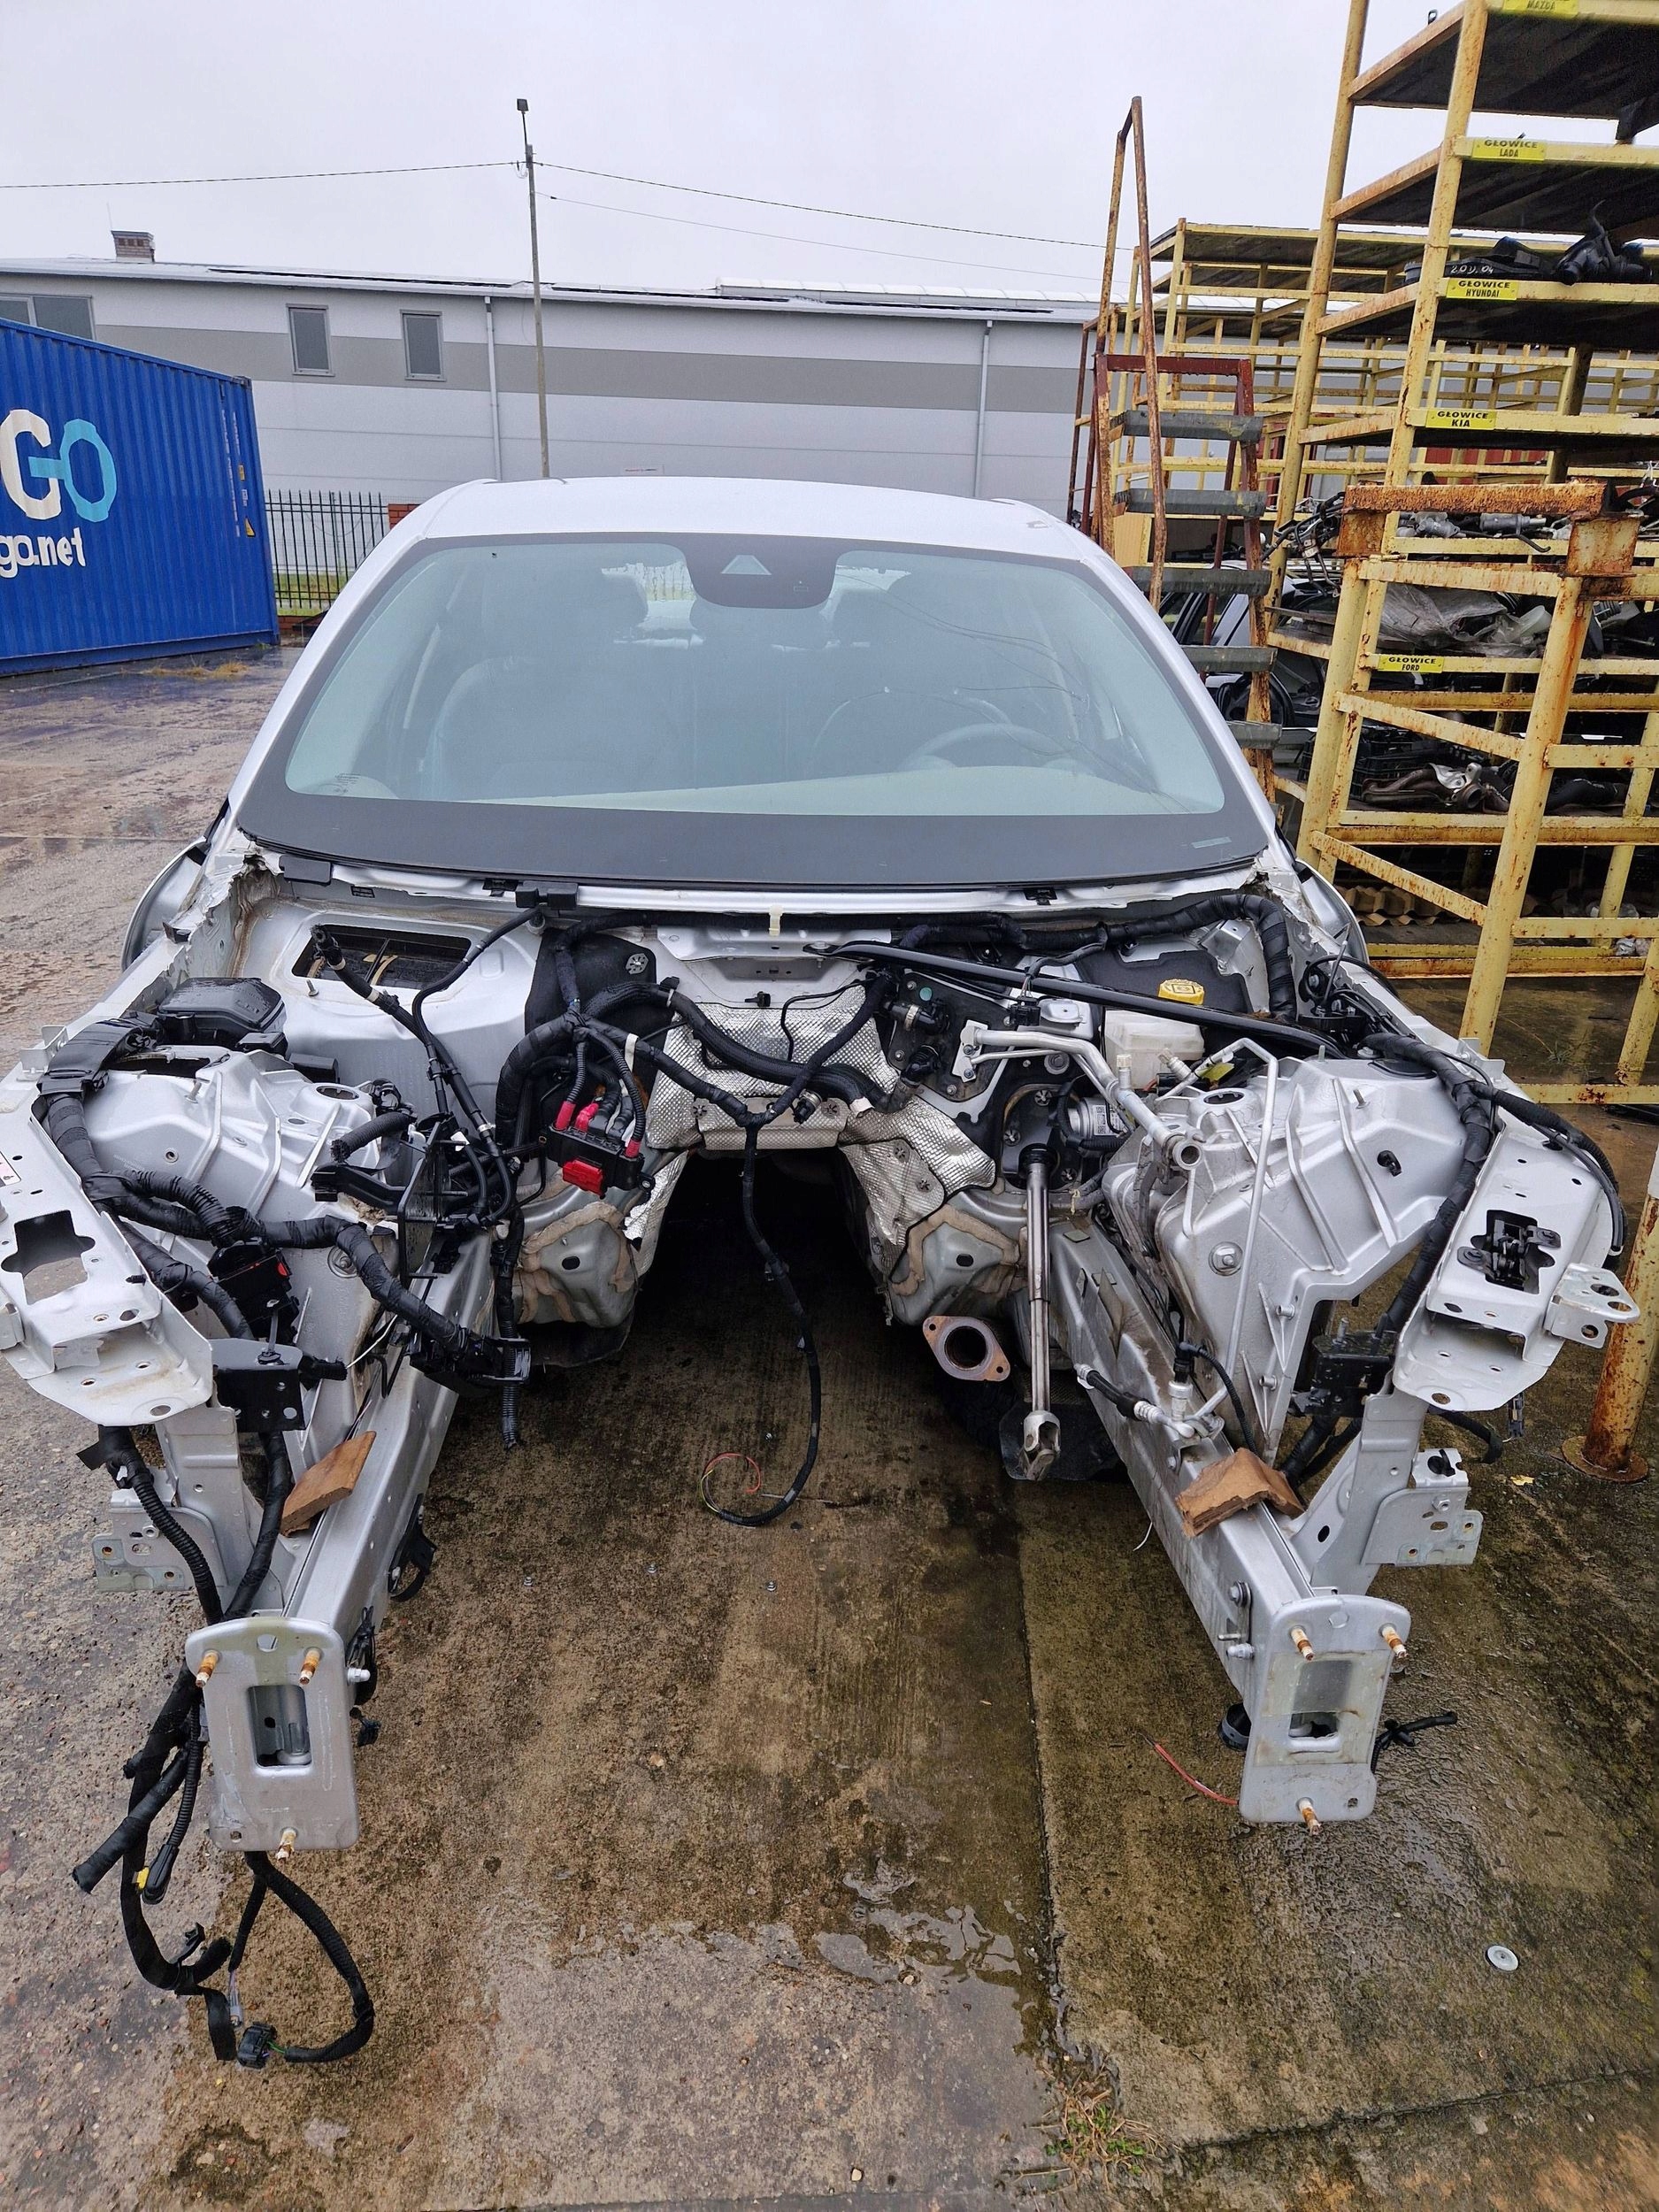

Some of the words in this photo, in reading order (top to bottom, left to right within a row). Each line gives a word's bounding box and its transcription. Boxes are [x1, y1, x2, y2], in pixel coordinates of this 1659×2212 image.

[1526, 0, 1555, 10] MAZDA
[1484, 139, 1538, 149] GŁOWICE
[1500, 149, 1518, 157] LADA
